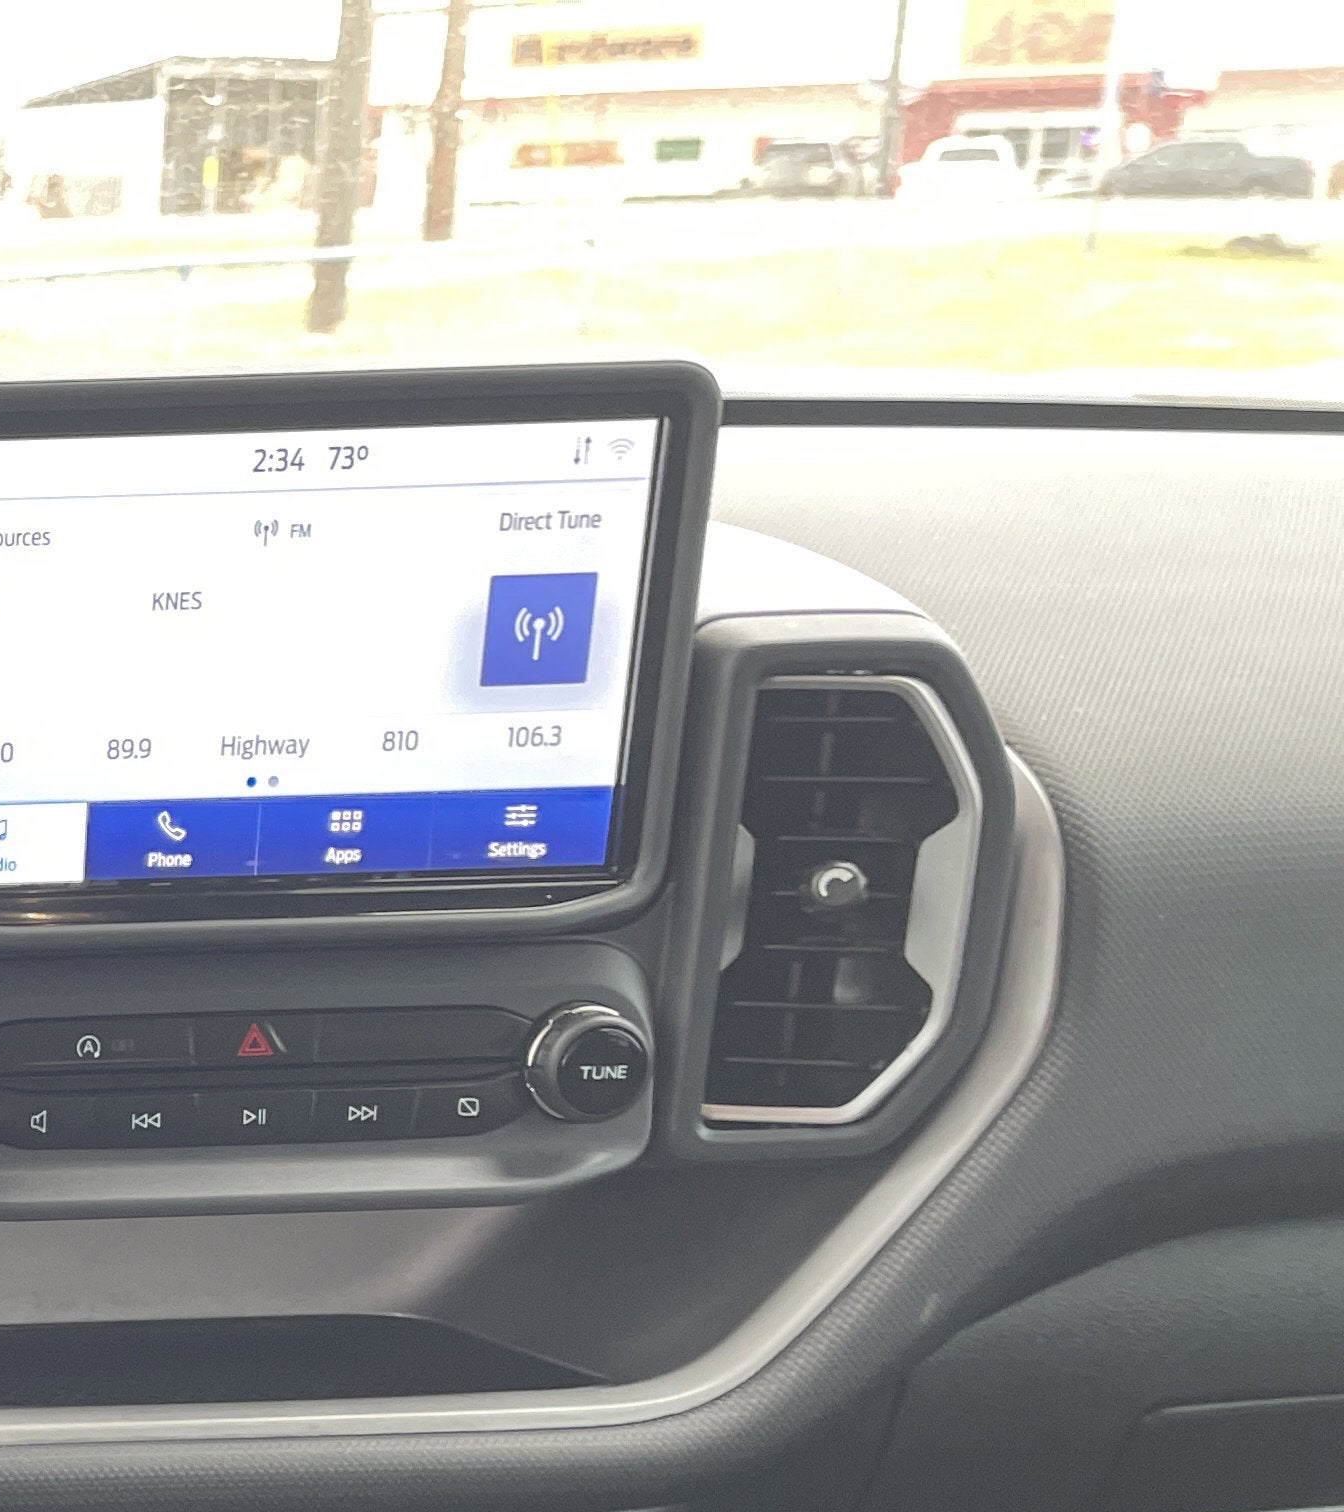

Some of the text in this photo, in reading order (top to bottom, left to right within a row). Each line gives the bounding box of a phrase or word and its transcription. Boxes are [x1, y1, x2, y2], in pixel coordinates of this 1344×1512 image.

[252, 448, 306, 474] 2:34
[290, 523, 313, 540] FM
[498, 509, 603, 533] Direct Tune
[151, 592, 203, 612] KNES
[106, 738, 153, 761] 89.9
[220, 734, 310, 760] Highway
[381, 730, 420, 753] 810
[506, 726, 563, 748] 106.3
[147, 849, 192, 870] Phone
[325, 845, 362, 866] Apps
[488, 840, 547, 860] Settings
[580, 1064, 628, 1082] TUNE
